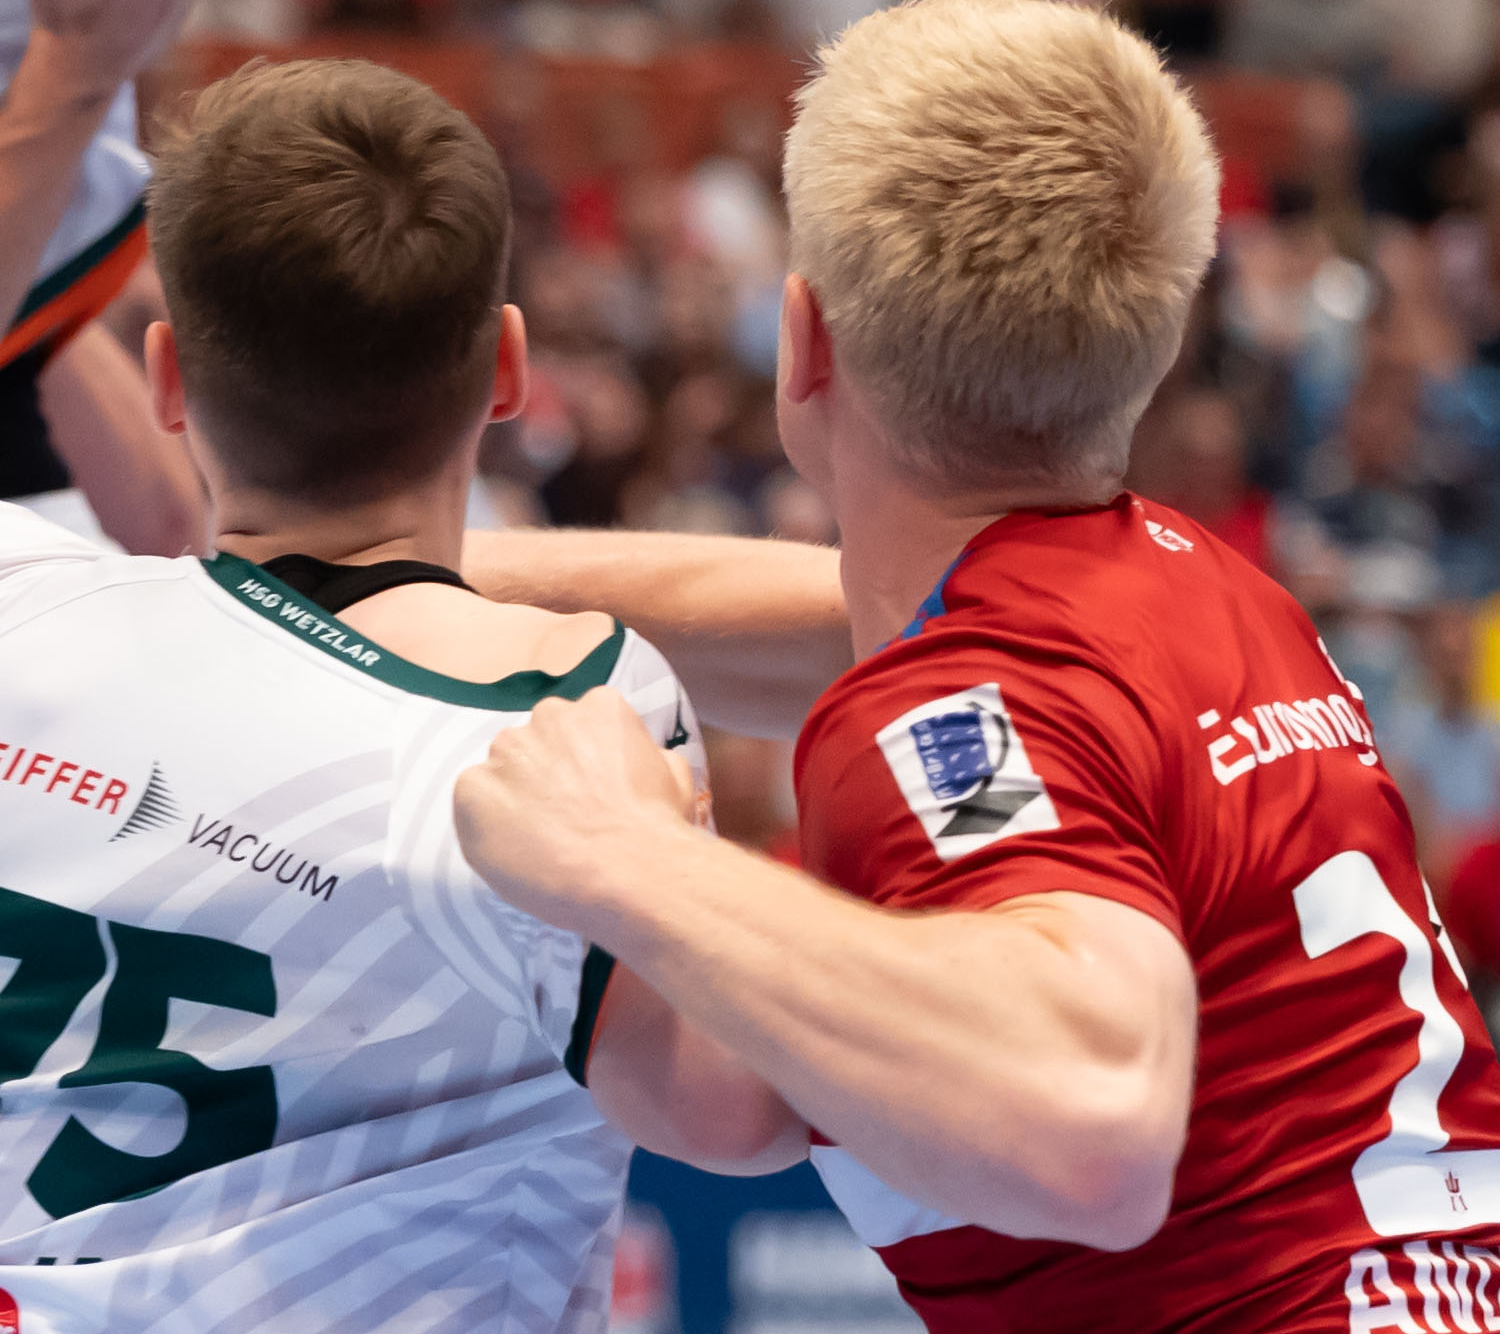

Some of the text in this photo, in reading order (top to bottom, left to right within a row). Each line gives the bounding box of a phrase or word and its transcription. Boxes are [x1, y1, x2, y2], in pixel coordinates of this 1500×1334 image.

[236, 578, 381, 667] HSG WETZLAR
[188, 812, 340, 902] VACUUM
